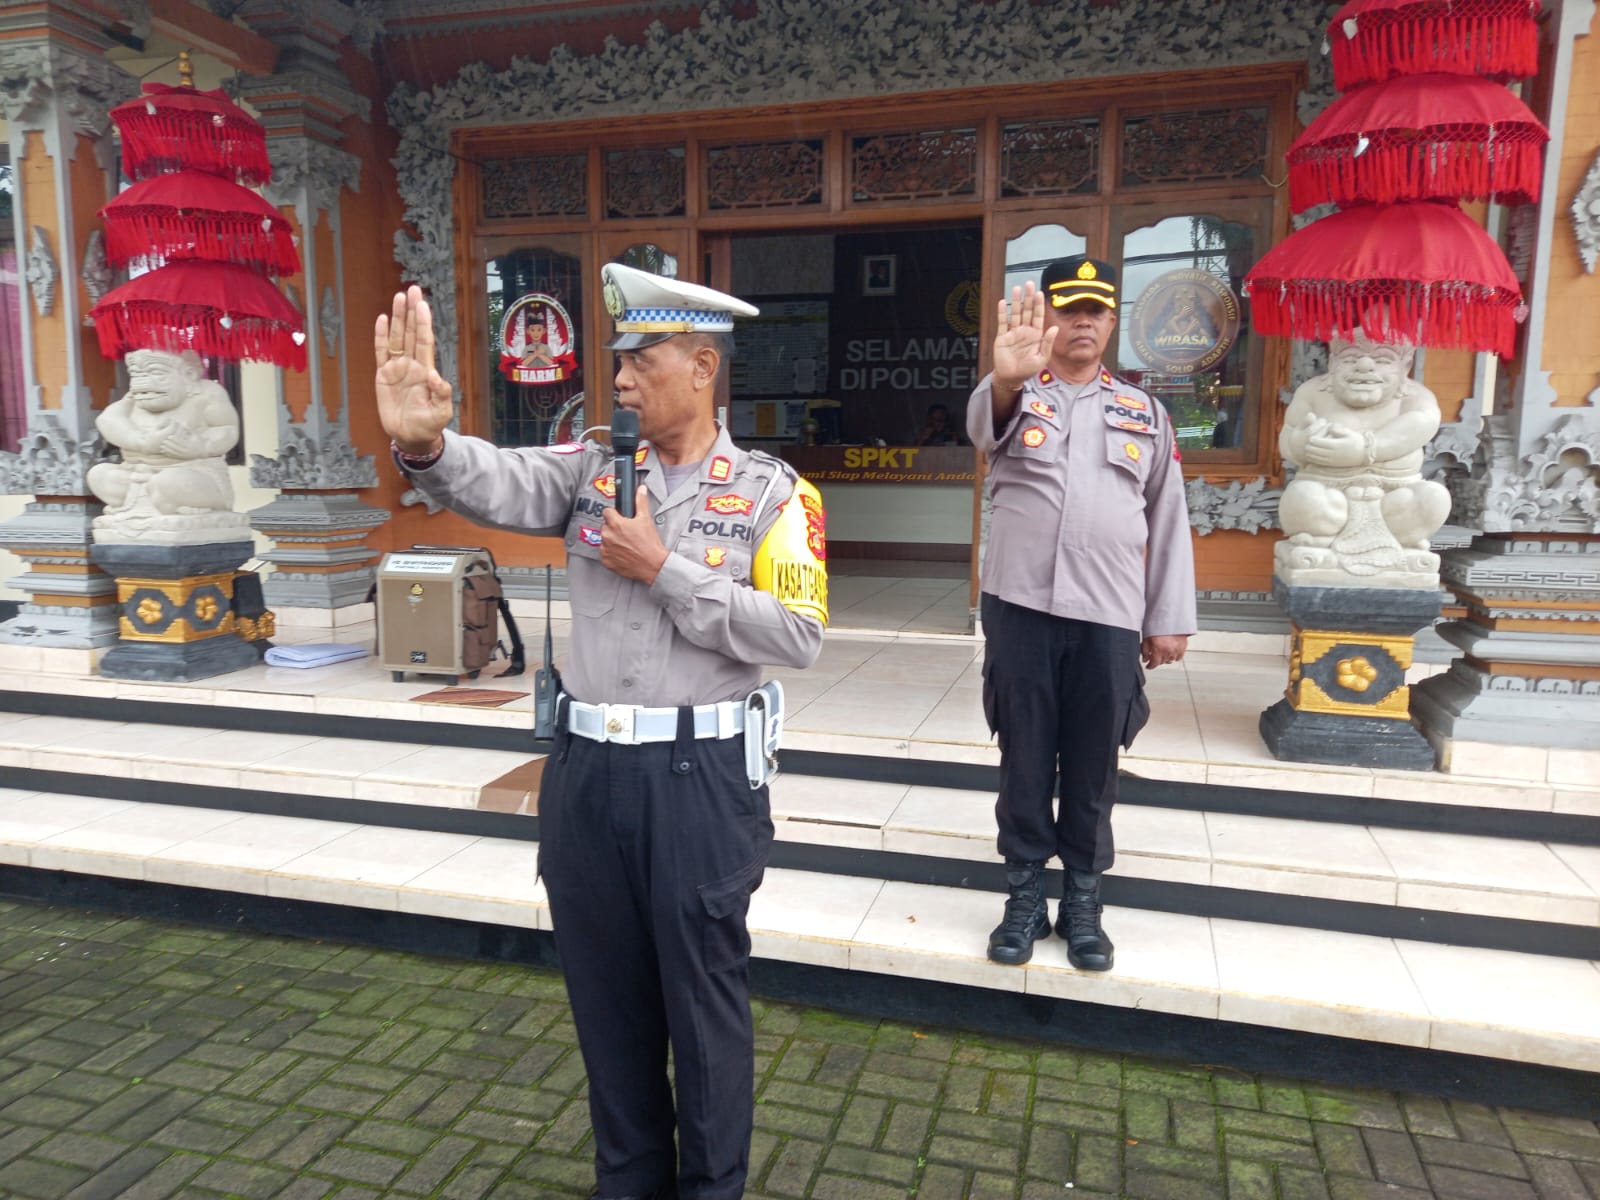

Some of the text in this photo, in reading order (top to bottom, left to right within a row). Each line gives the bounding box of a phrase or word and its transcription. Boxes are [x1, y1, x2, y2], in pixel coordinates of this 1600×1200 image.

[1210, 280, 1237, 321] RESPONSIF
[1154, 335, 1210, 347] WIRASA
[1200, 336, 1231, 367] ADAPTIF
[1165, 364, 1194, 373] SOLID
[1104, 404, 1152, 426] POLRI
[844, 448, 919, 468] SPKT
[829, 470, 861, 481] Siap
[862, 471, 932, 482] Melayani
[934, 472, 976, 481] Anda
[688, 519, 752, 541] POLRI
